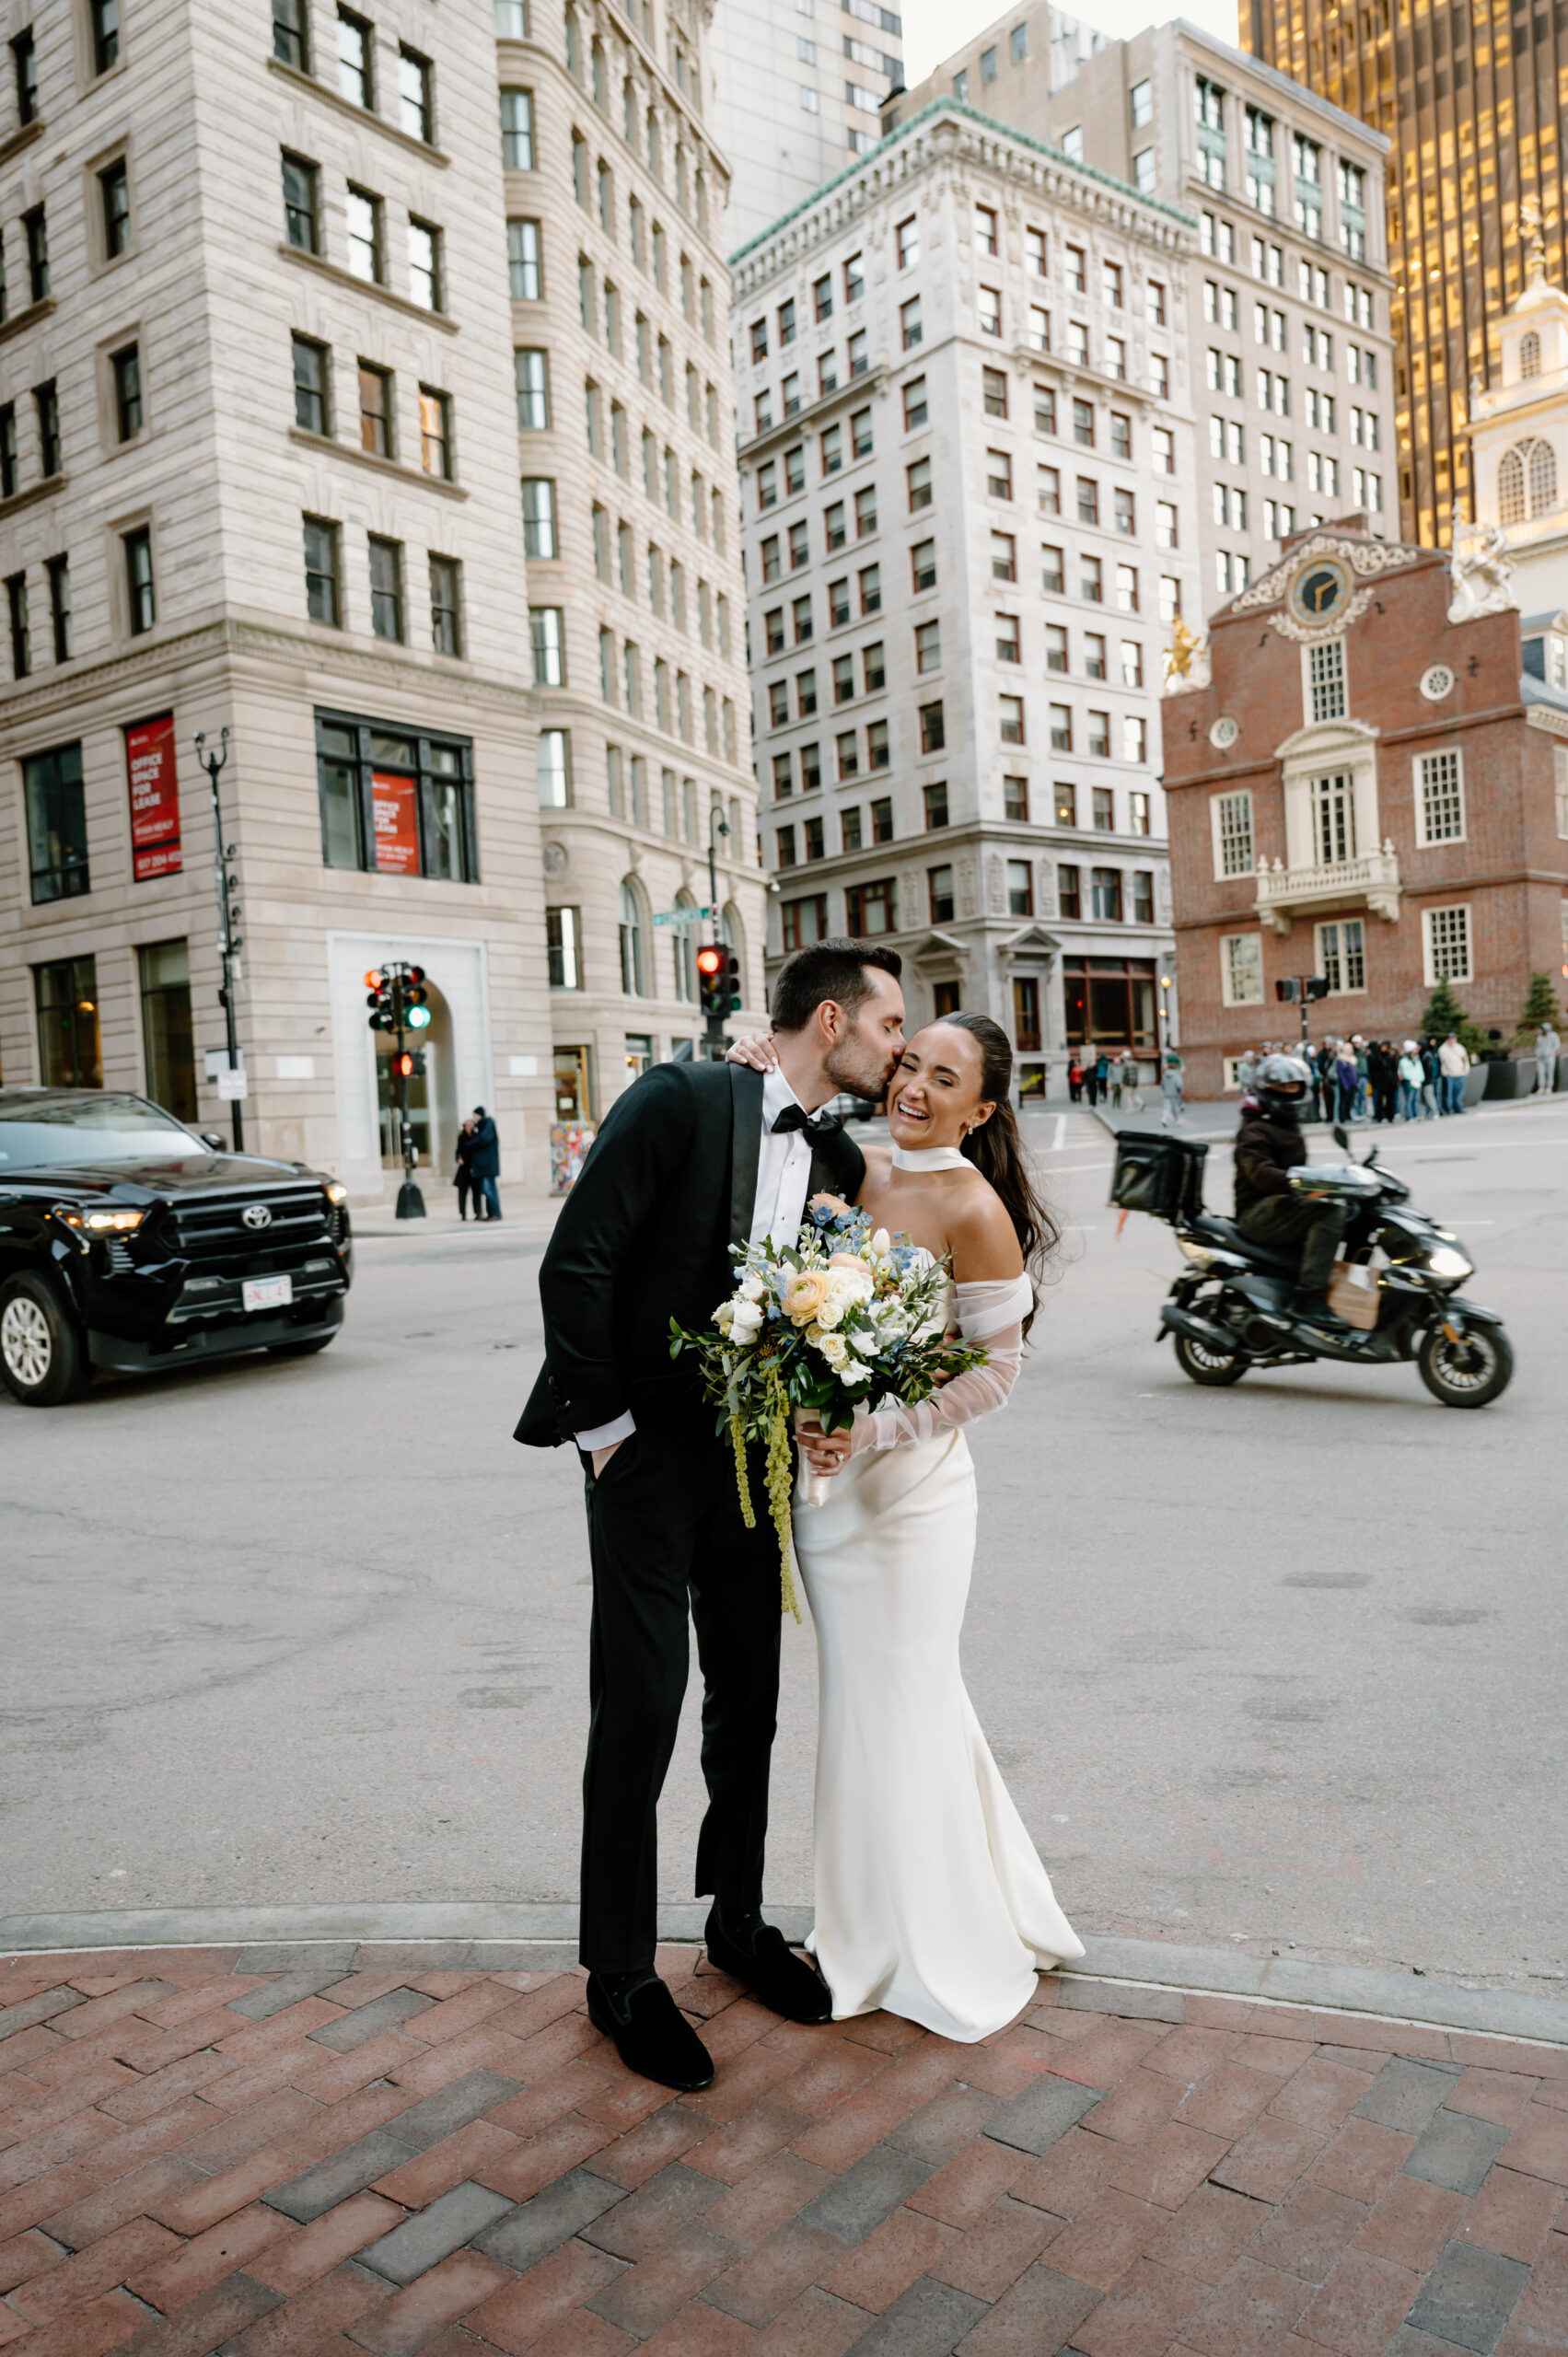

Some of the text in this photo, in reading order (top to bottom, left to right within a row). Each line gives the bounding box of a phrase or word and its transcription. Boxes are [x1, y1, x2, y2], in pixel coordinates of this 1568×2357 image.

[131, 752, 163, 771] OFFICE
[133, 782, 152, 796] FOR
[134, 793, 161, 810] LEASE
